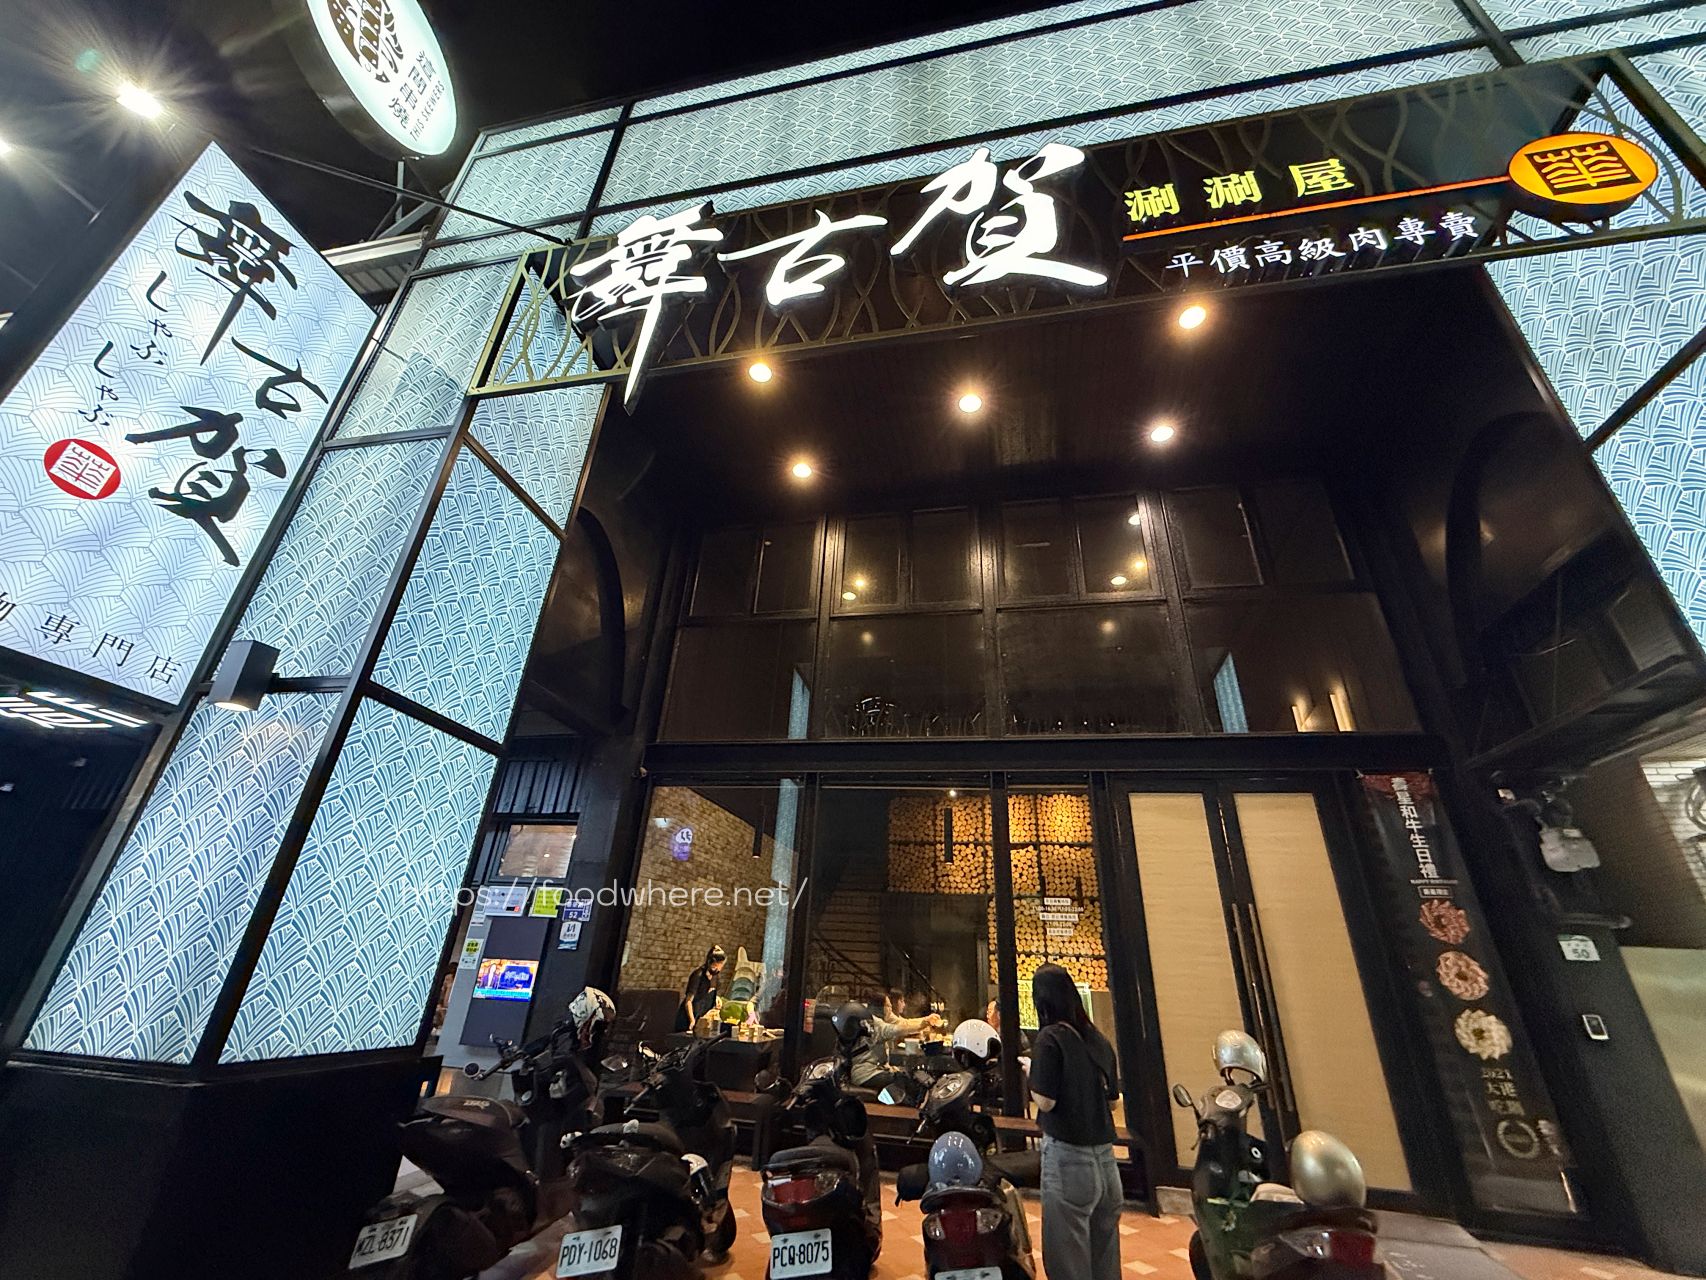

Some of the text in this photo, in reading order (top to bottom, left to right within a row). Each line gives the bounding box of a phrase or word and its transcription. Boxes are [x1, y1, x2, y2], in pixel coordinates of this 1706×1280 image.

[388, 50, 437, 130] 這間串燒
[409, 80, 446, 142] THIS SKEWERS
[1124, 158, 1355, 222] 涮涮屋
[1165, 211, 1480, 278] 平價高級肉專賣
[568, 911, 578, 919] 52
[559, 1238, 618, 1268] PDY-1068
[772, 1240, 829, 1269] PCQ-8075
